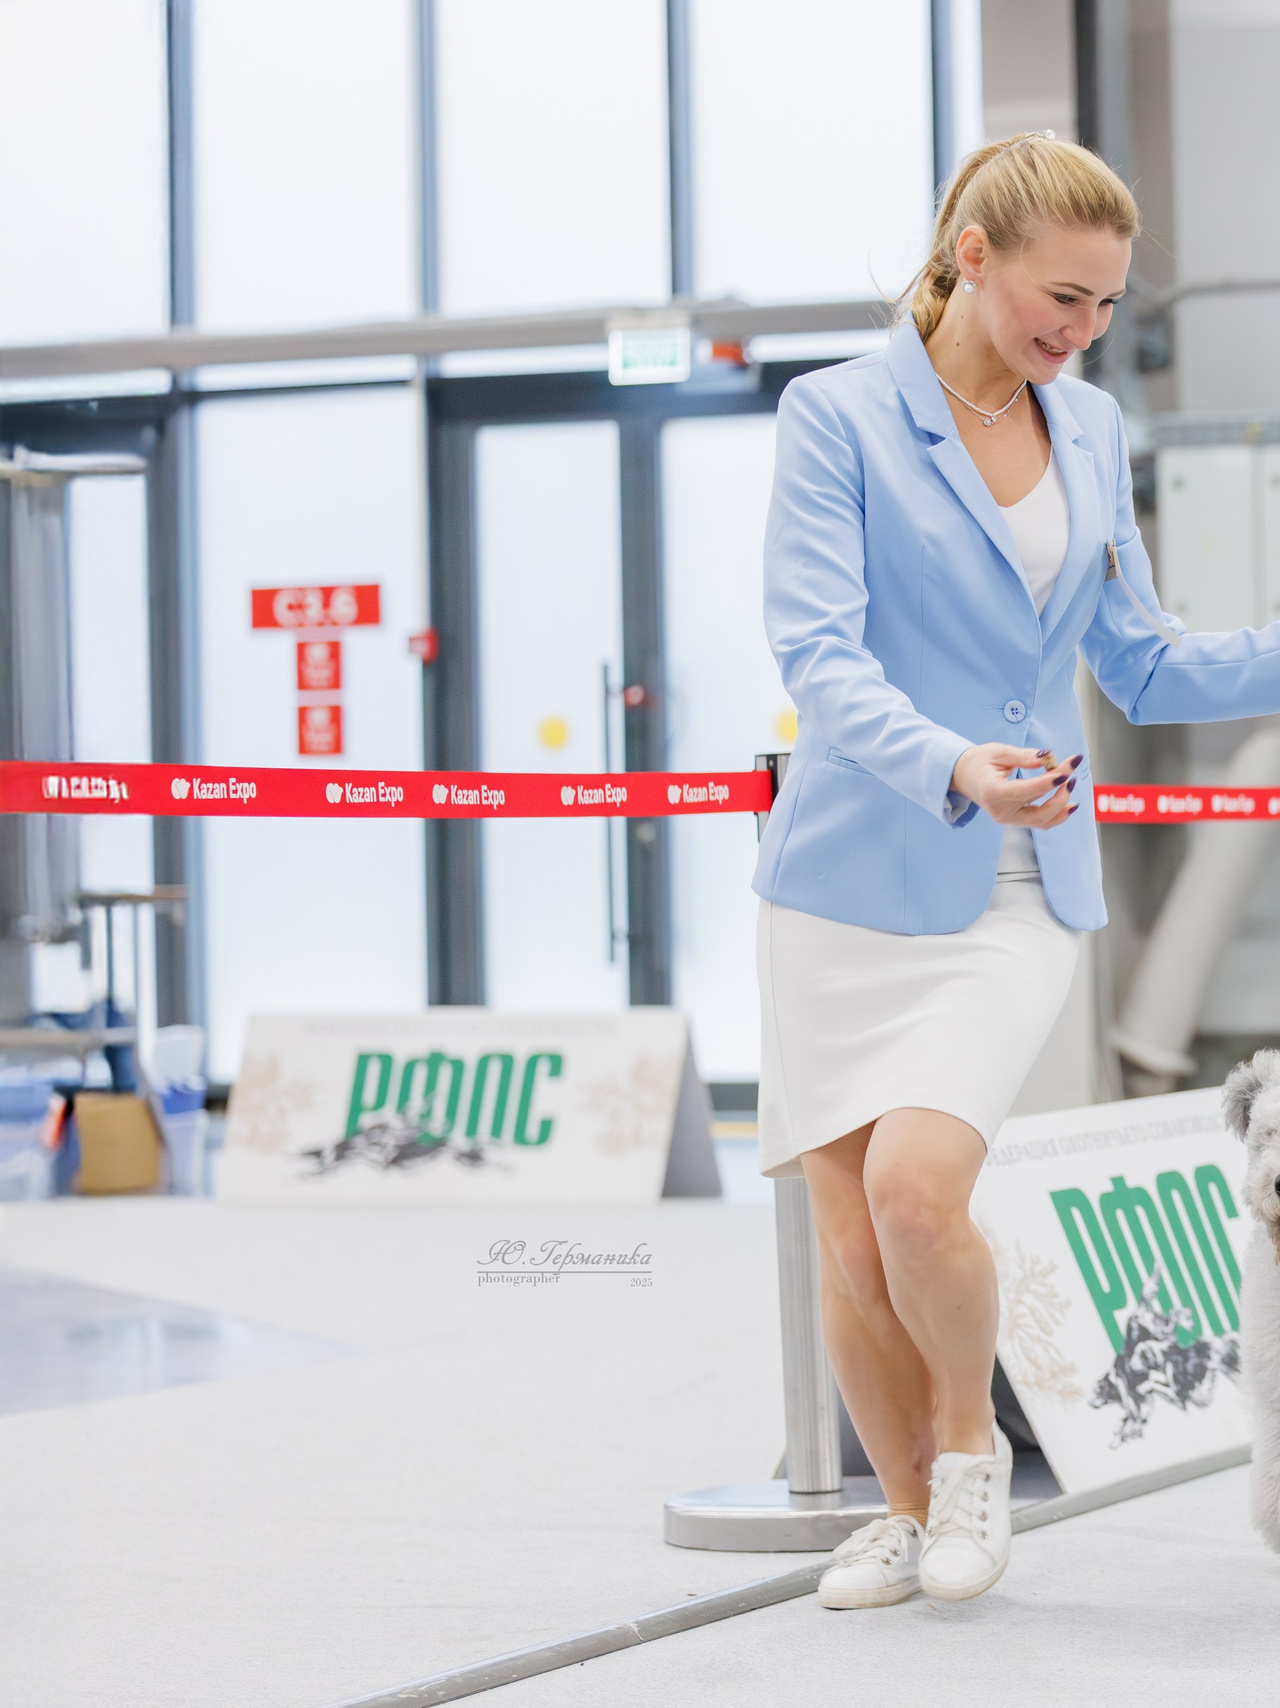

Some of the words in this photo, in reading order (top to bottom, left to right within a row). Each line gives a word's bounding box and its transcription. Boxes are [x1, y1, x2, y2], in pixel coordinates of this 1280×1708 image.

[192, 777, 228, 800] Kazan
[228, 777, 257, 805] Expo
[345, 782, 377, 804] Kazan
[378, 781, 405, 808] Expo
[450, 784, 481, 805] Kazan
[481, 784, 506, 811] Expo
[577, 785, 605, 805] Kazan
[605, 783, 628, 808] Expo
[682, 783, 708, 804] Kazan
[708, 781, 730, 806] Expo
